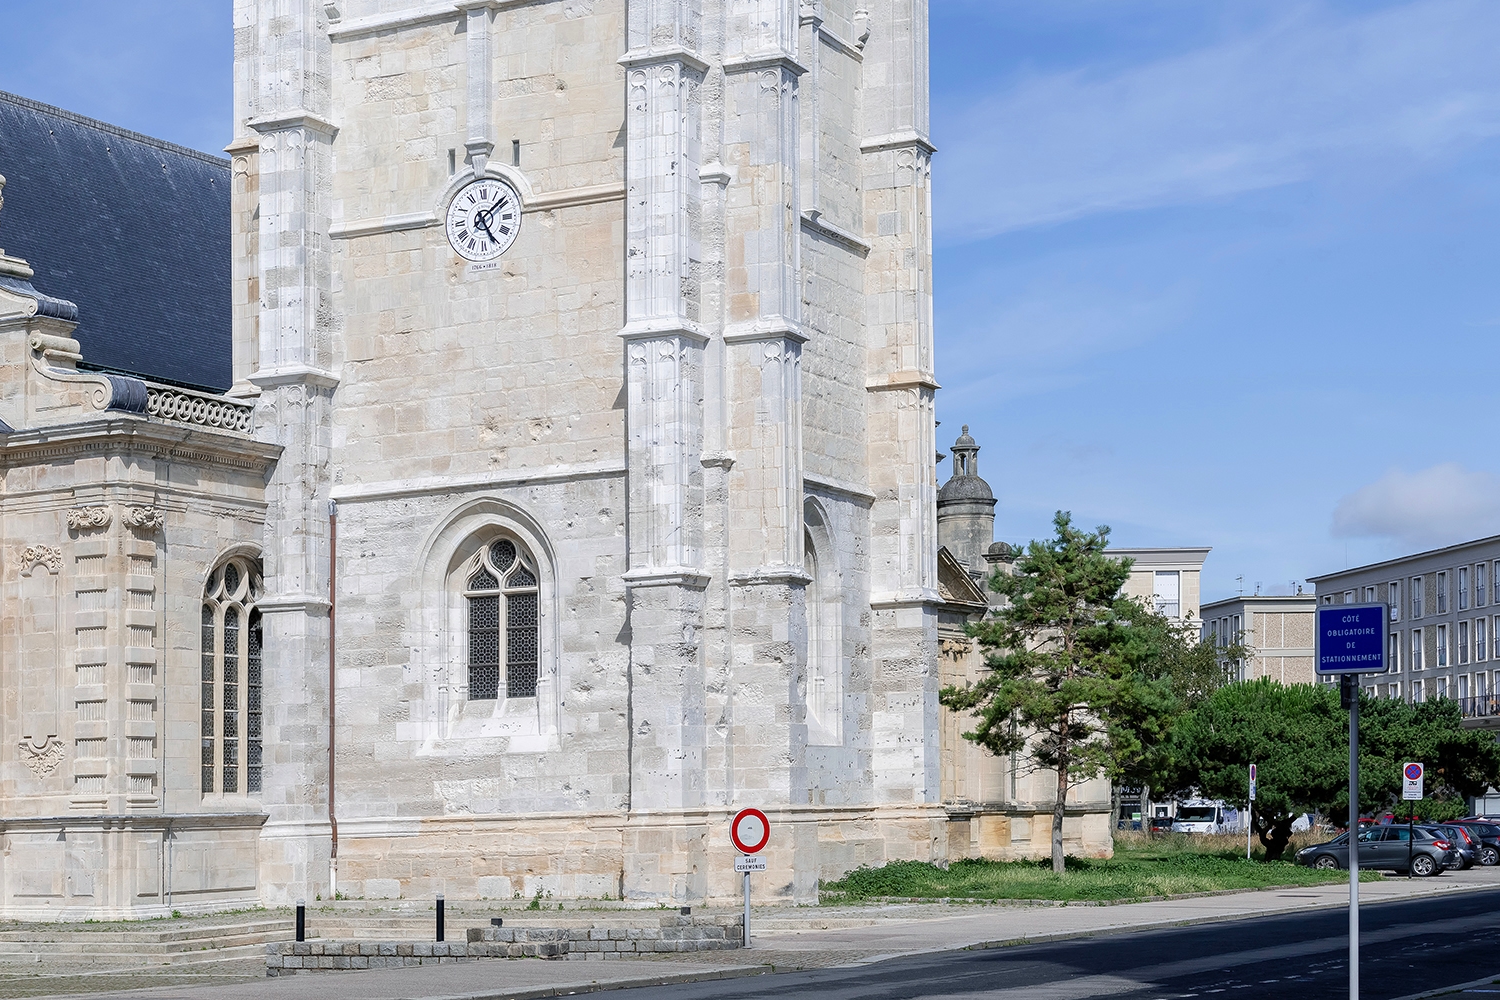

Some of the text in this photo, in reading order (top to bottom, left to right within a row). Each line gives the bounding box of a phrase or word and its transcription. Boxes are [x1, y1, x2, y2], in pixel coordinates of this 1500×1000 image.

[1342, 614, 1360, 623] CÔTÉ
[1327, 627, 1375, 637] OBLIGATOIRE
[1321, 653, 1381, 663] STATIONNEMENT
